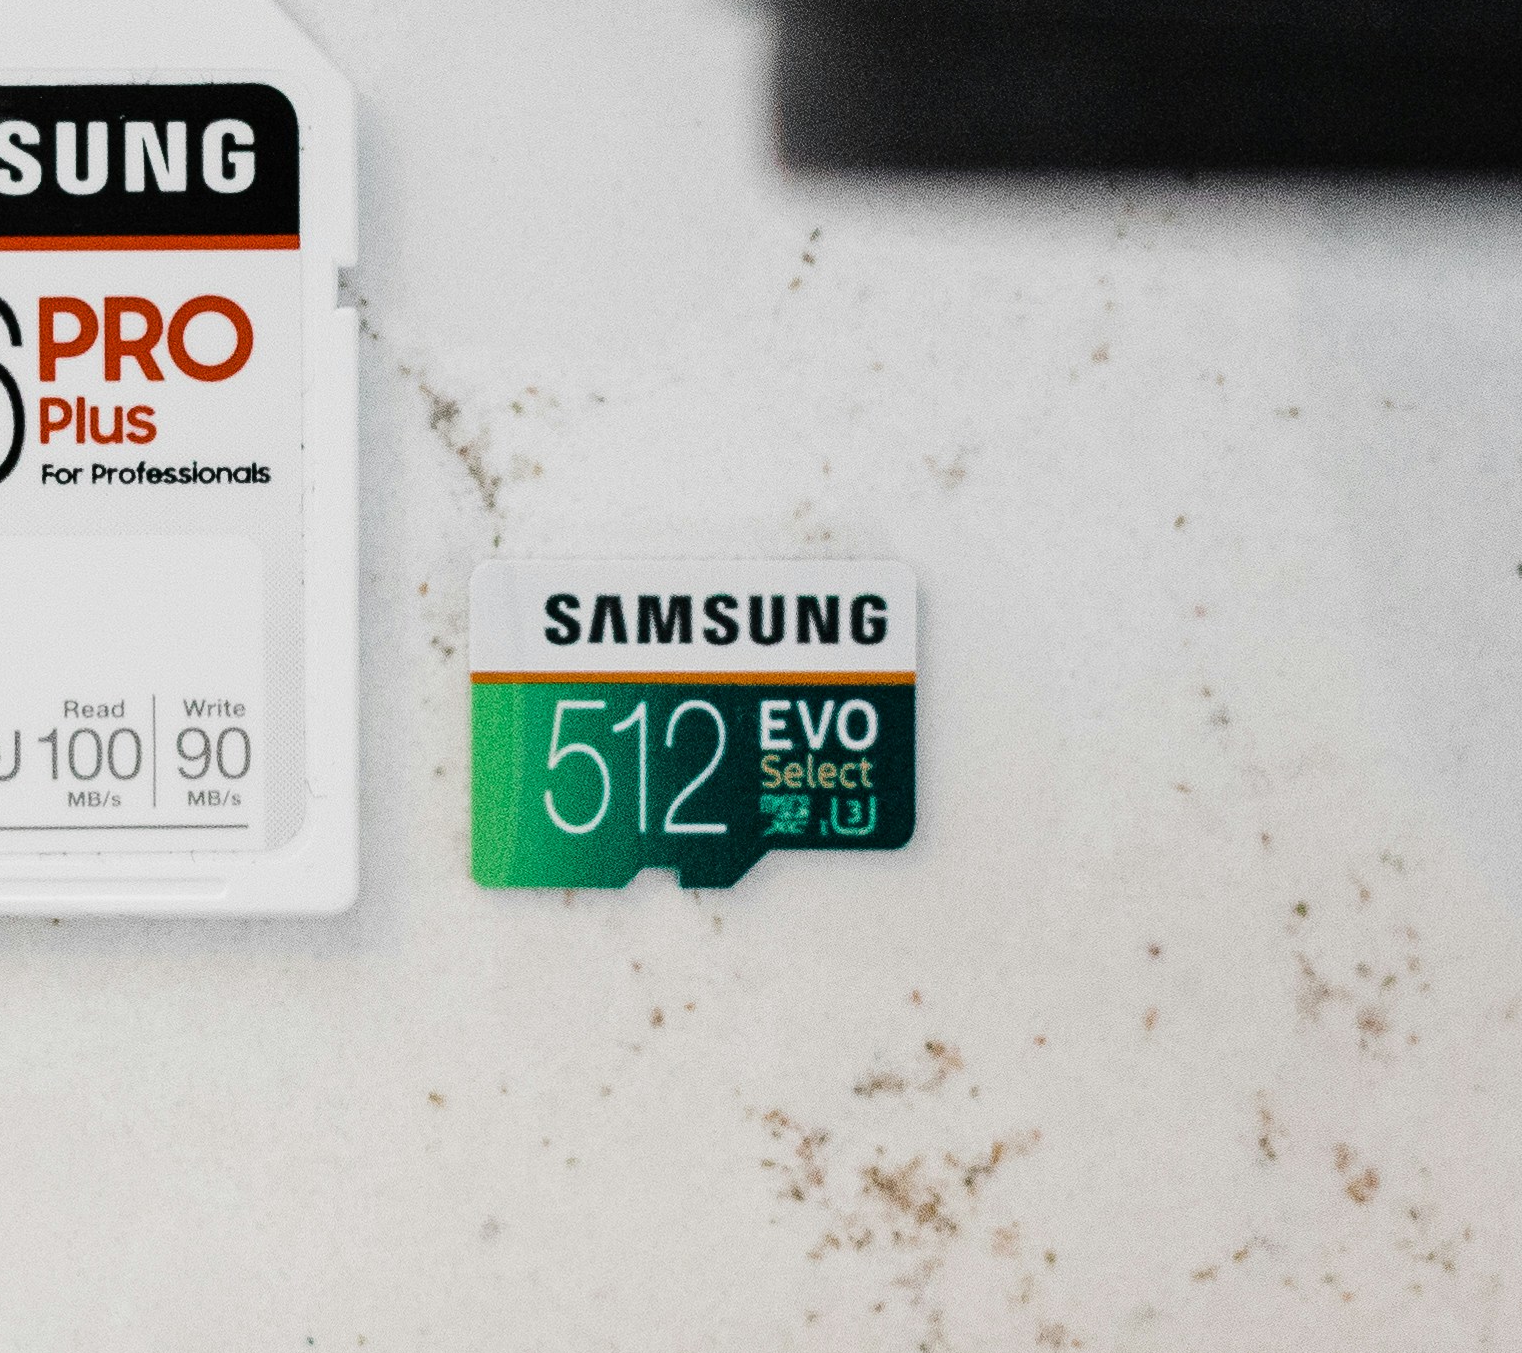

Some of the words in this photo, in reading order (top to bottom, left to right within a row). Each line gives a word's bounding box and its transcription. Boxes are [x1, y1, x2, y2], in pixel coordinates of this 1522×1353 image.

[38, 294, 255, 383] PRO
[39, 396, 158, 445] Plus
[41, 463, 84, 485] For
[91, 461, 271, 485] Professionals
[544, 592, 889, 646] SAMSUNG
[63, 699, 125, 719] Read
[183, 698, 246, 718] Write
[759, 698, 879, 751] EVO
[38, 727, 143, 781] 100
[175, 726, 252, 780] 90
[541, 698, 728, 836] 512
[760, 753, 874, 789] Select
[66, 790, 122, 807] MB/s
[186, 789, 242, 806] MB/s
